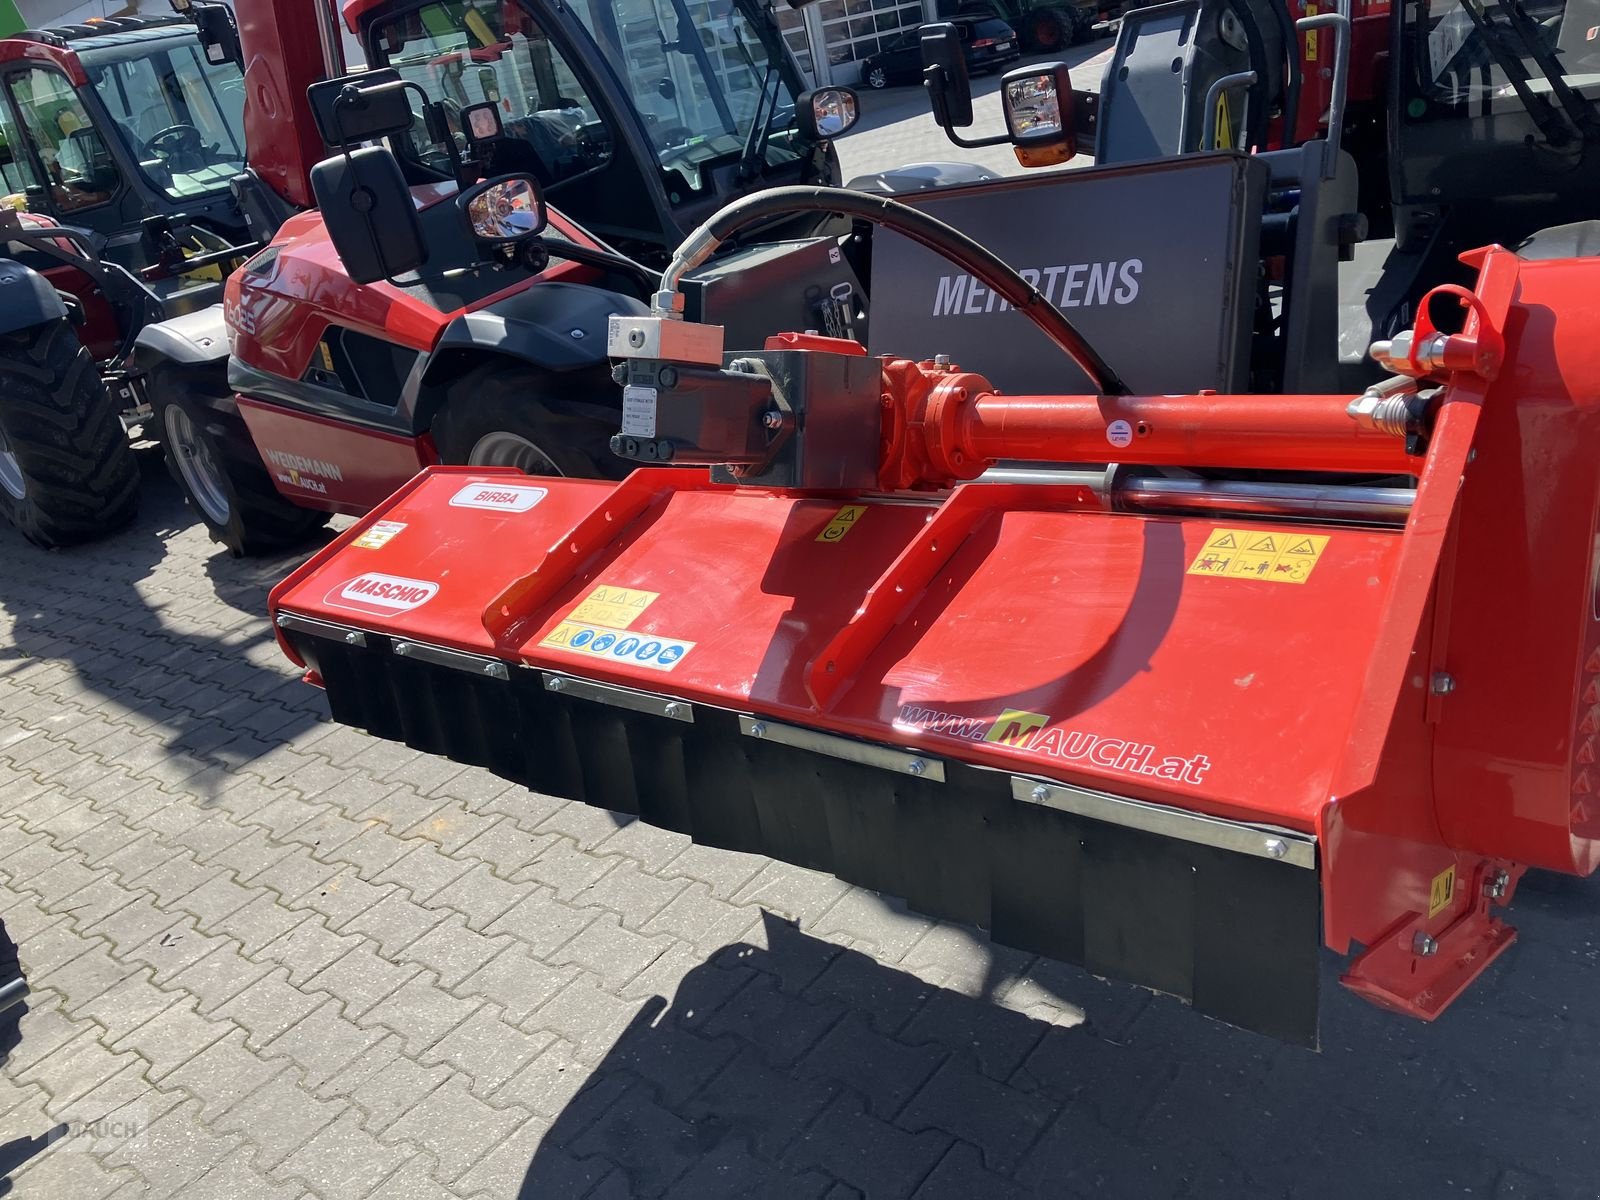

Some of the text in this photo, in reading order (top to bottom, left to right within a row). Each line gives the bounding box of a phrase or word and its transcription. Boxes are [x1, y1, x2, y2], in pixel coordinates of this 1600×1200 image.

[265, 448, 343, 481] WEIDEMANN
[474, 491, 519, 504] BIRBA
[348, 579, 429, 603] MASCHIO
